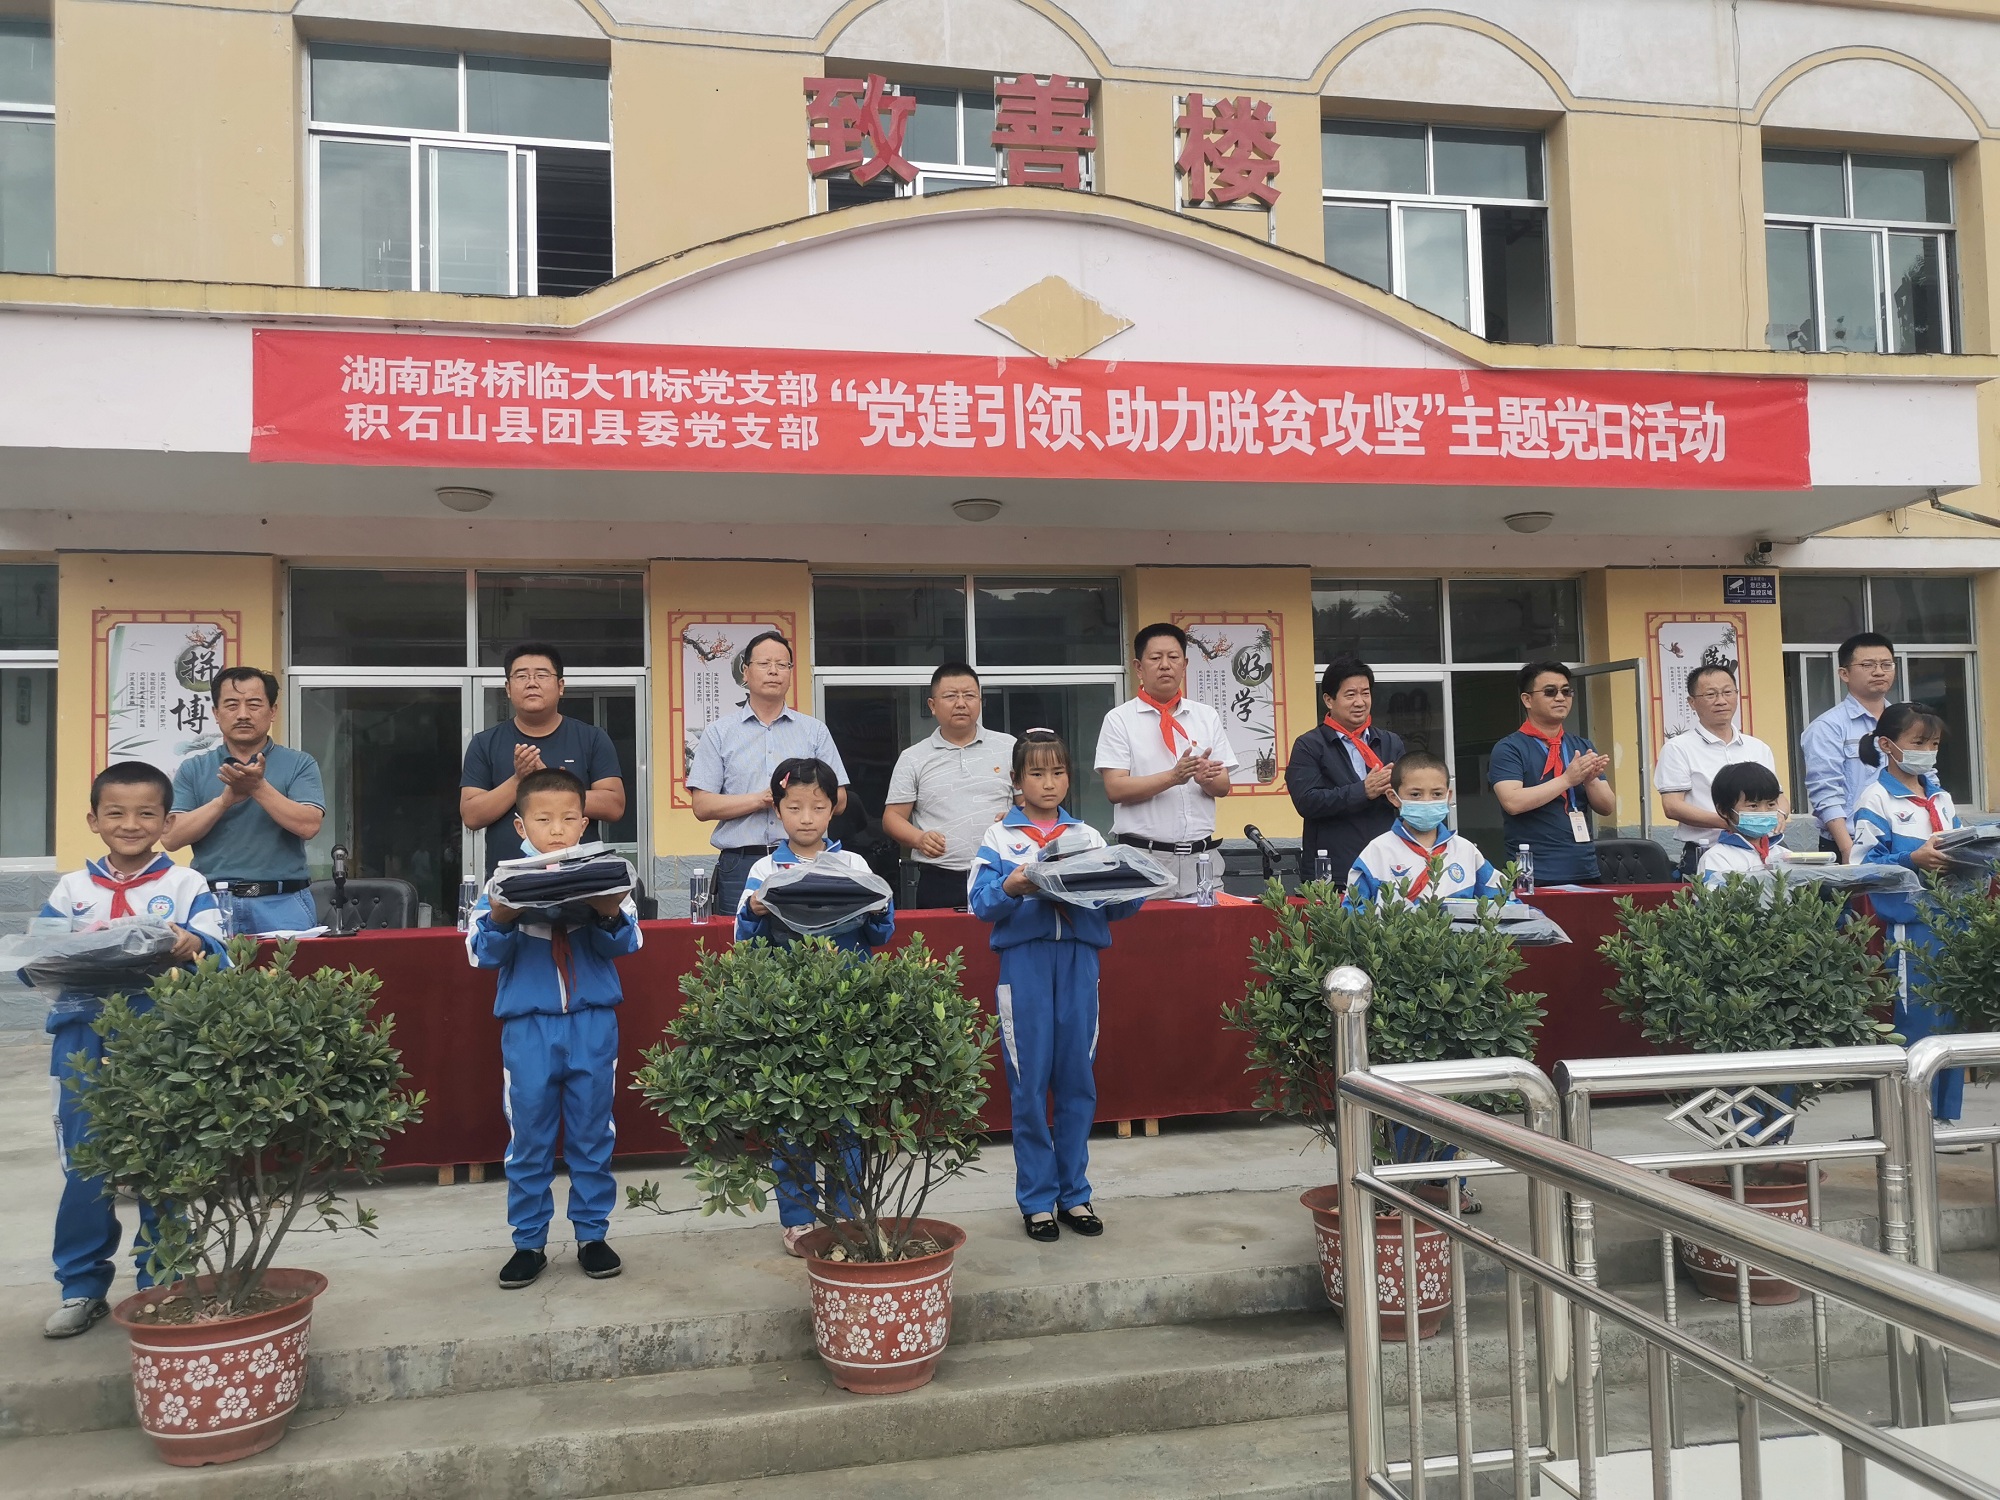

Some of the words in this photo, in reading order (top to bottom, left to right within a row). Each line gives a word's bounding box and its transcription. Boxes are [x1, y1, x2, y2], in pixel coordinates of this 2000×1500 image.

[803, 73, 1282, 207] 致善楼
[339, 354, 819, 408] 湖南路桥临大11标党支部
[344, 402, 819, 451] 积石山县团县委党支部
[831, 377, 1726, 463] “党建引领、助力脱贫攻坚”主题党日活动
